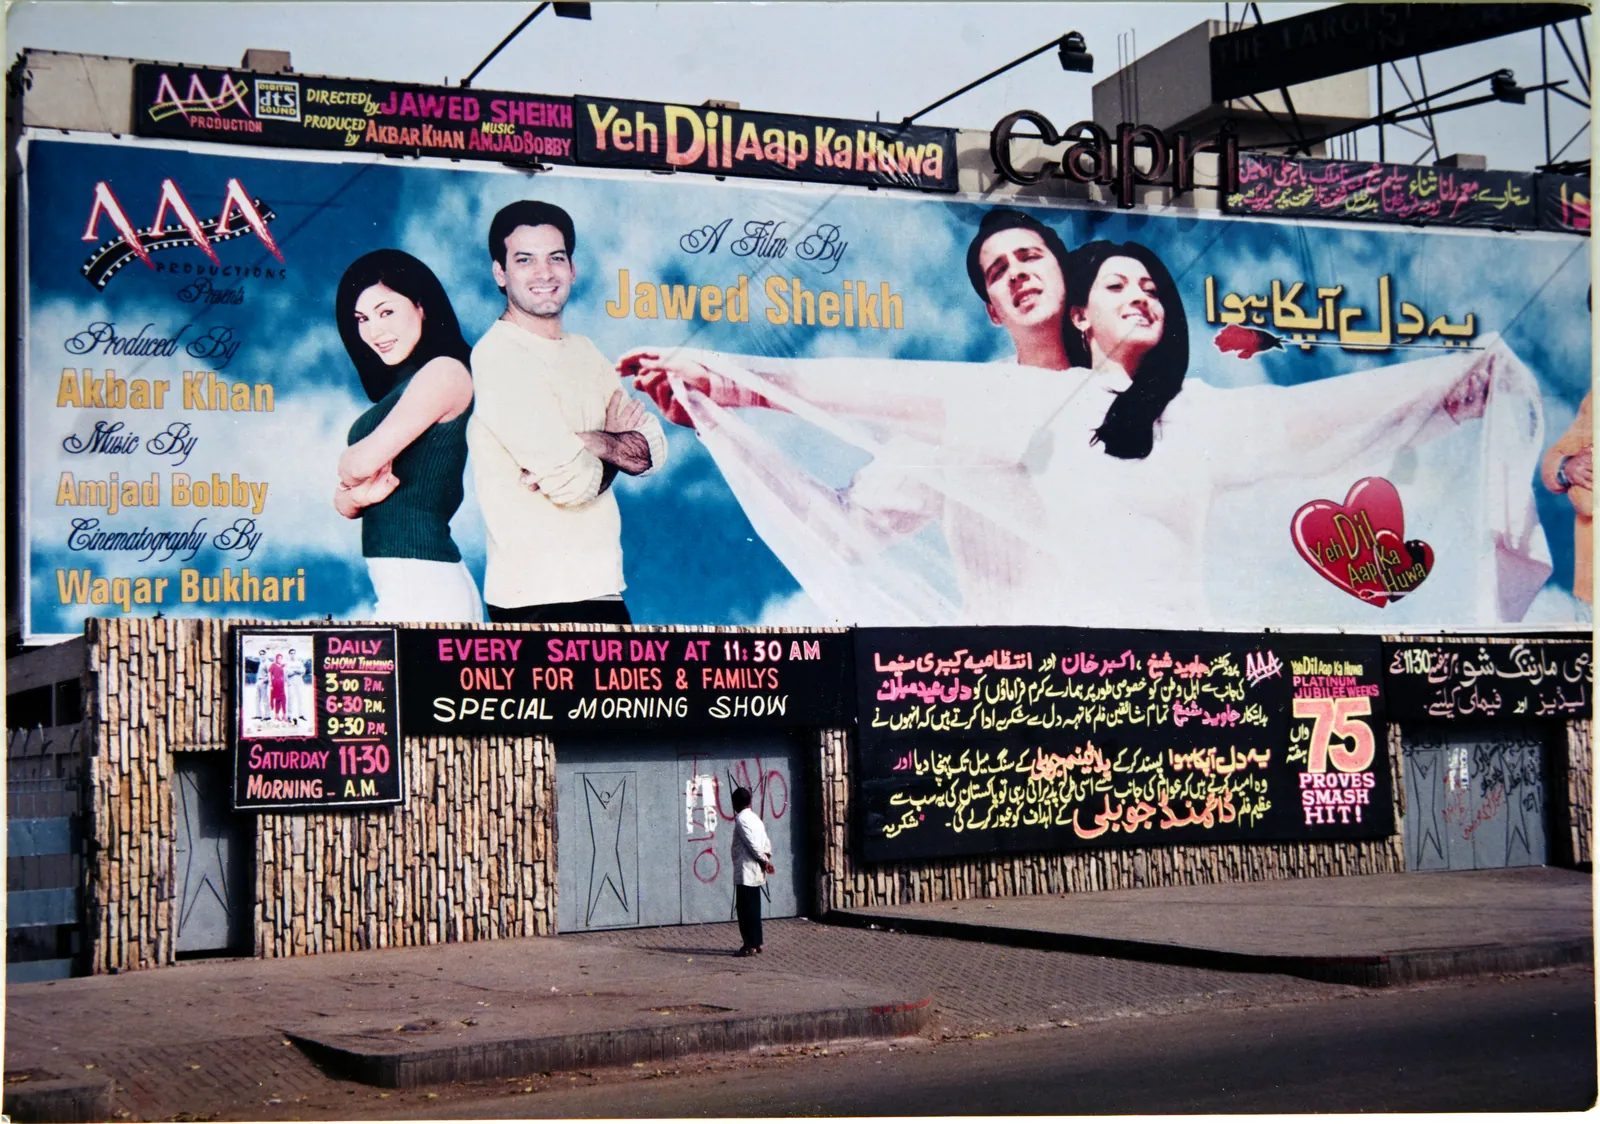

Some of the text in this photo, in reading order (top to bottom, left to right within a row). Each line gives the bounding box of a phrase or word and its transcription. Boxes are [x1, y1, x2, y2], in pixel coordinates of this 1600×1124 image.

[258, 83, 295, 92] DIGITAL
[259, 89, 296, 108] dts
[259, 106, 297, 117] SOUND
[306, 88, 366, 107] DIRECTED
[380, 91, 481, 122] JAWED
[490, 99, 573, 129] SHEIKH
[190, 117, 263, 134] PRODUCTION
[304, 114, 366, 131] PRODUCED
[481, 121, 515, 135] MUSIC
[344, 130, 360, 147] by
[587, 103, 943, 180] Yeh Dil Aap Ka Huwa
[680, 218, 848, 275] A Film By
[155, 262, 287, 279] PRODUCTIONS
[177, 278, 245, 305] Presents
[605, 269, 904, 330] Jawed Sheikh
[64, 322, 242, 370] Produced By
[56, 367, 275, 412] Akbar Khan
[62, 420, 198, 466] Music By
[56, 471, 268, 515] Amjad Bobby
[67, 517, 263, 562] Cinematography By
[1309, 510, 1378, 567] Yeh Dil
[1348, 545, 1401, 589] Aap Ka
[1381, 563, 1426, 595] Huwa
[56, 567, 306, 613] Waqar Bukhari
[328, 637, 383, 655] DAILY
[438, 638, 523, 661] EVERY
[684, 640, 712, 661] AT
[789, 640, 821, 660] AM
[323, 656, 358, 670] SHOW
[964, 649, 1032, 676] انتظامیہ
[1038, 652, 1057, 672] اور
[1062, 652, 1099, 675] خان
[1099, 650, 1135, 677] اکبر
[460, 667, 779, 690] ONLY FOR LADIES & FAMILYS
[973, 674, 987, 700] کو
[1028, 674, 1051, 706] کرم
[1293, 676, 1357, 687] PLATINUM
[1294, 684, 1379, 698] JUBILEE WEEKS
[432, 695, 789, 723] SPECIAL MORNING SHOW
[871, 706, 888, 728] نے
[981, 708, 995, 729] ادا
[1042, 702, 1062, 729] دل
[1147, 703, 1169, 727] تمام
[1202, 704, 1240, 728] جاوید
[1293, 696, 1375, 773] 75
[249, 744, 390, 775] SATURDAY 11-30
[893, 751, 912, 770] اور
[1015, 748, 1030, 772] کے
[1247, 748, 1271, 769] یہ
[246, 774, 380, 799] MORNING A.M.
[1299, 773, 1375, 789] PROVES
[889, 792, 904, 806] سے
[1302, 788, 1370, 806] SMASH
[1073, 793, 1157, 840] جوبلی
